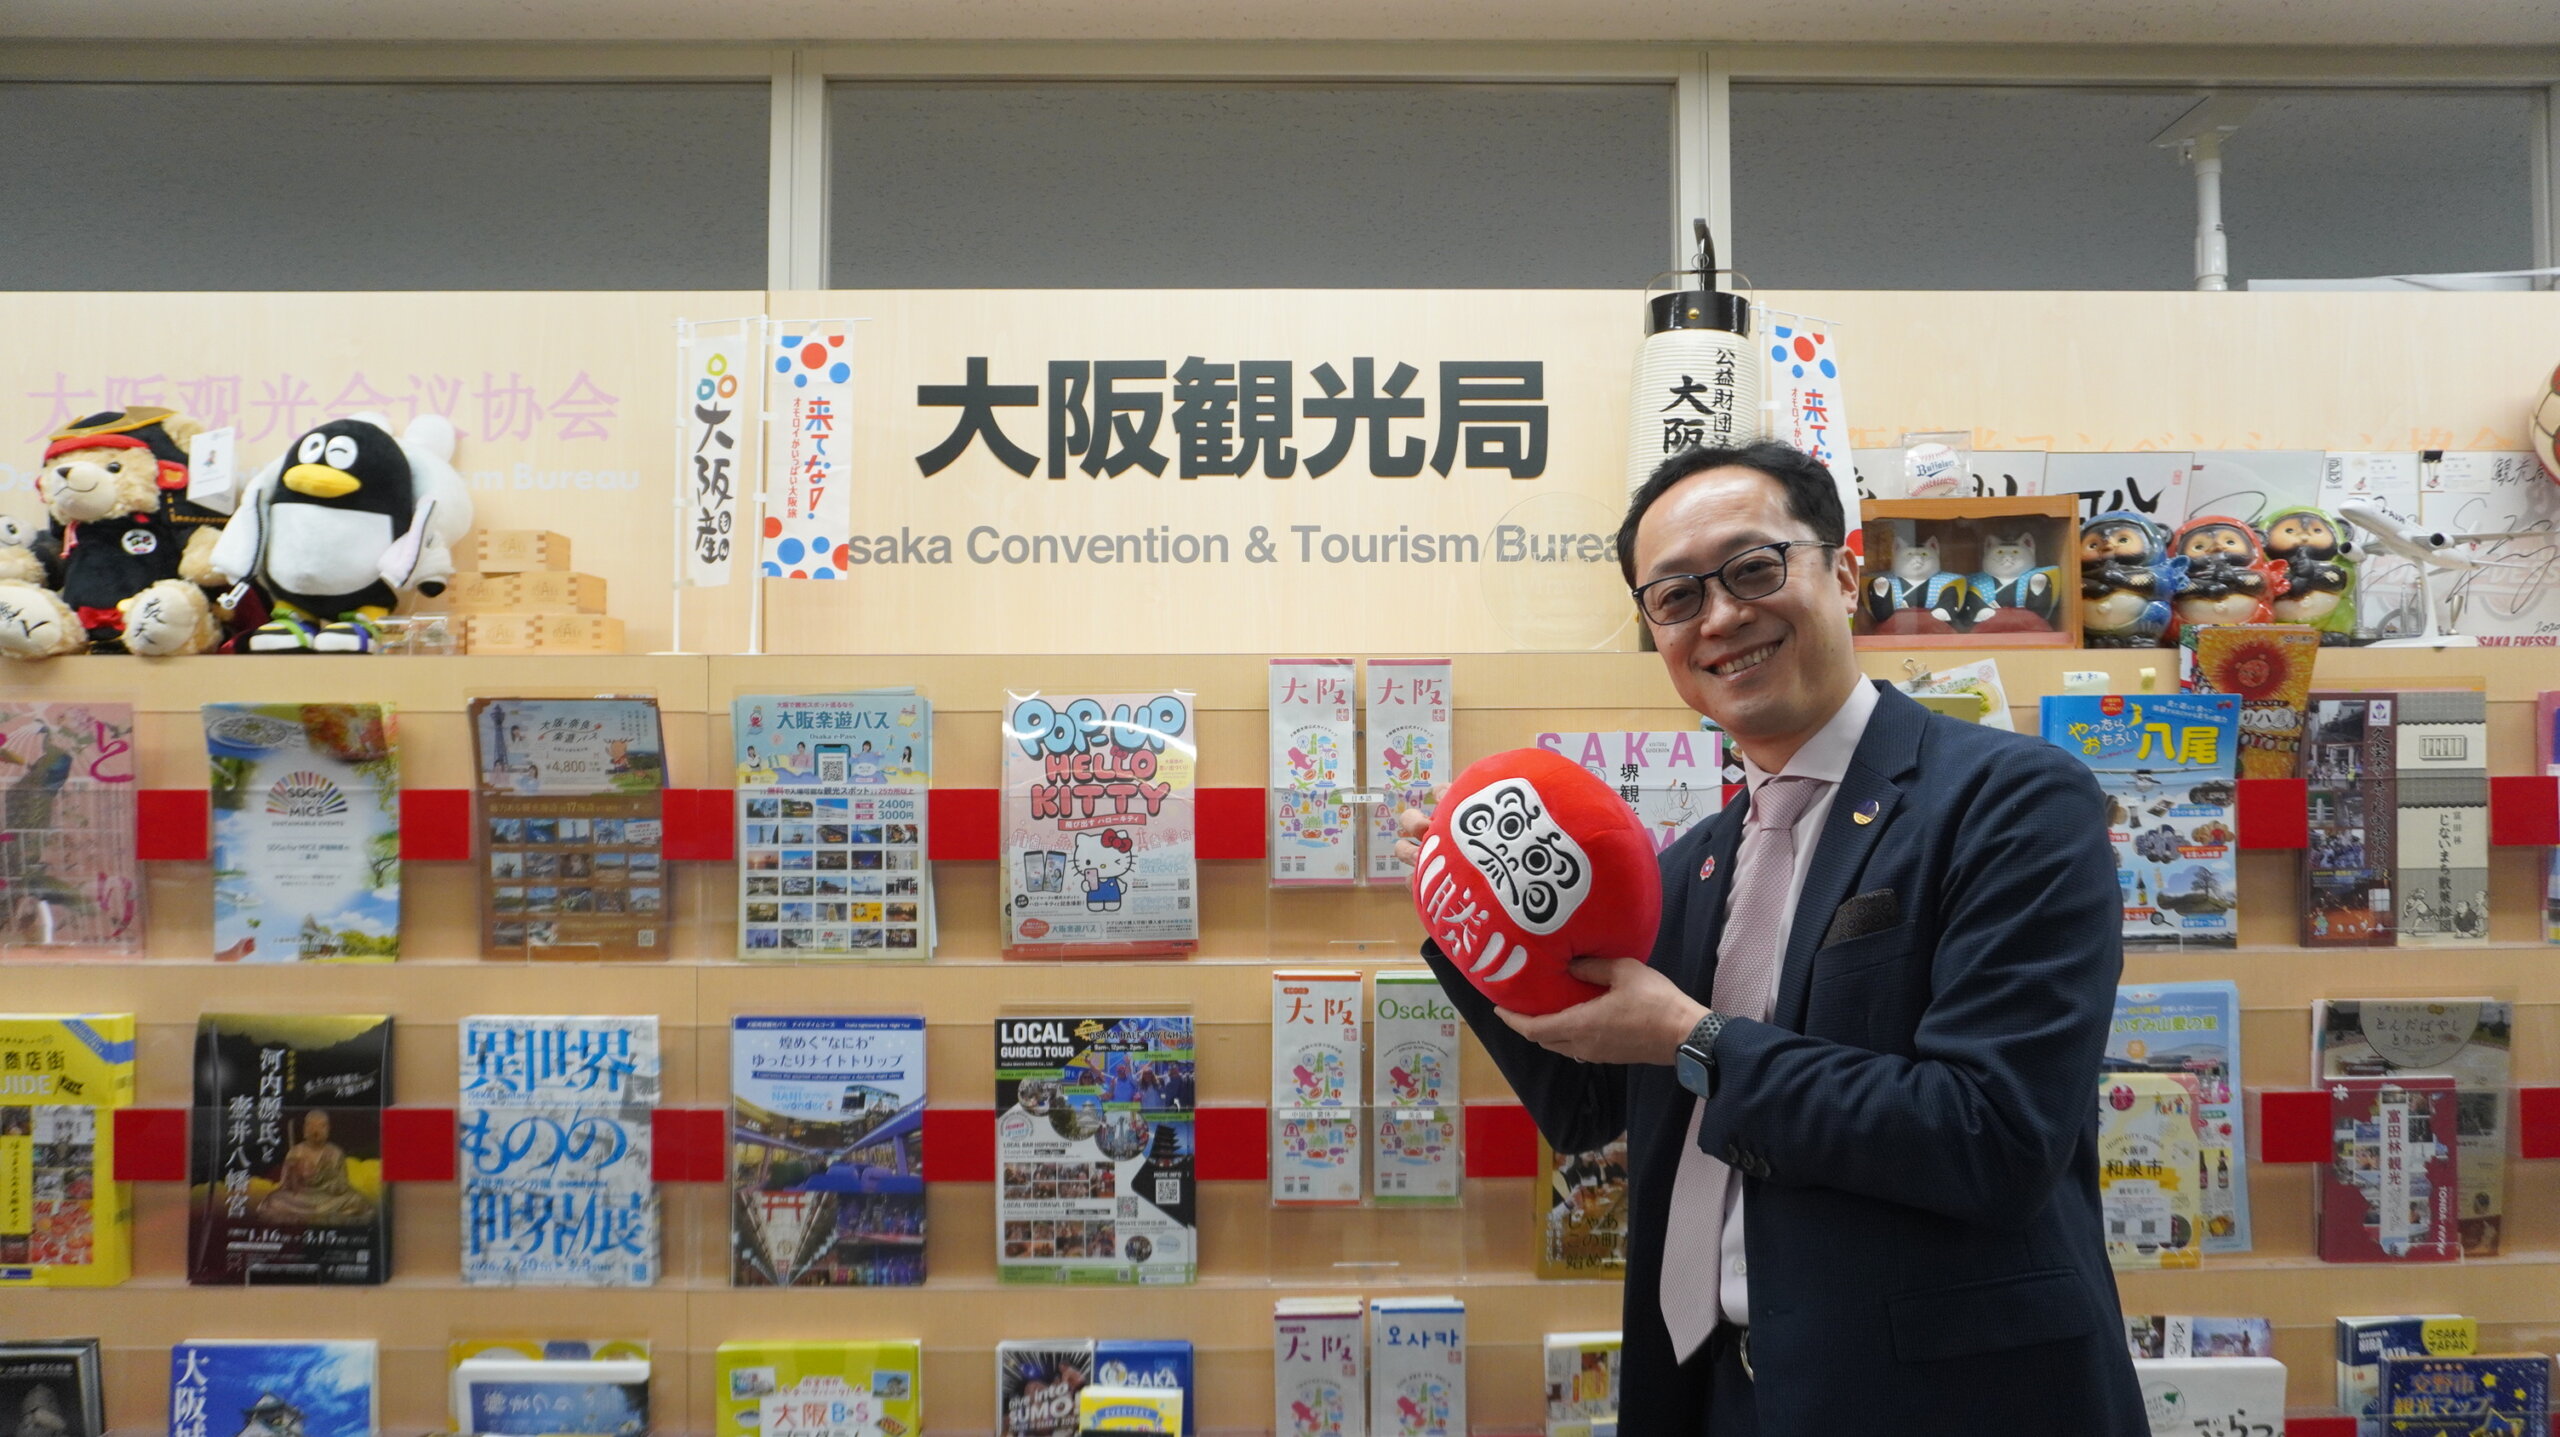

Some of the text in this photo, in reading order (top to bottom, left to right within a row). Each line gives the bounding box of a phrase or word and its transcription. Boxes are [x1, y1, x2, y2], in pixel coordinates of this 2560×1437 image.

[24, 371, 622, 444] 大阪观光会议协会
[914, 355, 1549, 480] 大阪観光局
[512, 463, 641, 492] Bureau
[848, 524, 1619, 566] saka Convention & Tourism Burea
[1281, 677, 1347, 705] 大阪
[1377, 678, 1444, 705] 大阪
[777, 711, 890, 730] 大阪楽遊パス
[1013, 696, 1187, 761] POP-UP
[1536, 732, 1723, 768] SAKAI
[2136, 722, 2220, 765] 八尾
[1045, 749, 1158, 785] HELLO
[1031, 782, 1171, 820] KITTY
[1620, 763, 1640, 816] 堺観
[289, 806, 324, 817] MICE
[878, 799, 914, 810] 2400円
[878, 810, 914, 820] 3000円
[1286, 997, 1356, 1025] 大阪
[1378, 999, 1456, 1021] Osaka
[1001, 1022, 1070, 1044] LOCAL
[1089, 1031, 1118, 1040] OSAKA
[463, 1029, 638, 1093] 異世界
[752, 1054, 904, 1069] ゆったりナイトトリップ
[1001, 1046, 1075, 1058] GUIDED TOUR
[2387, 1109, 2403, 1186] 富田林観光
[2105, 1158, 2164, 1178] 和泉市
[1567, 1232, 1628, 1248] この町
[1283, 1334, 1353, 1361] 大阪
[1388, 1325, 1459, 1349] 오사카
[2428, 1328, 2468, 1340] OSAKA
[2428, 1341, 2468, 1352] JAPAN
[1035, 1382, 1069, 1402] into
[1009, 1395, 1073, 1424] SUMO
